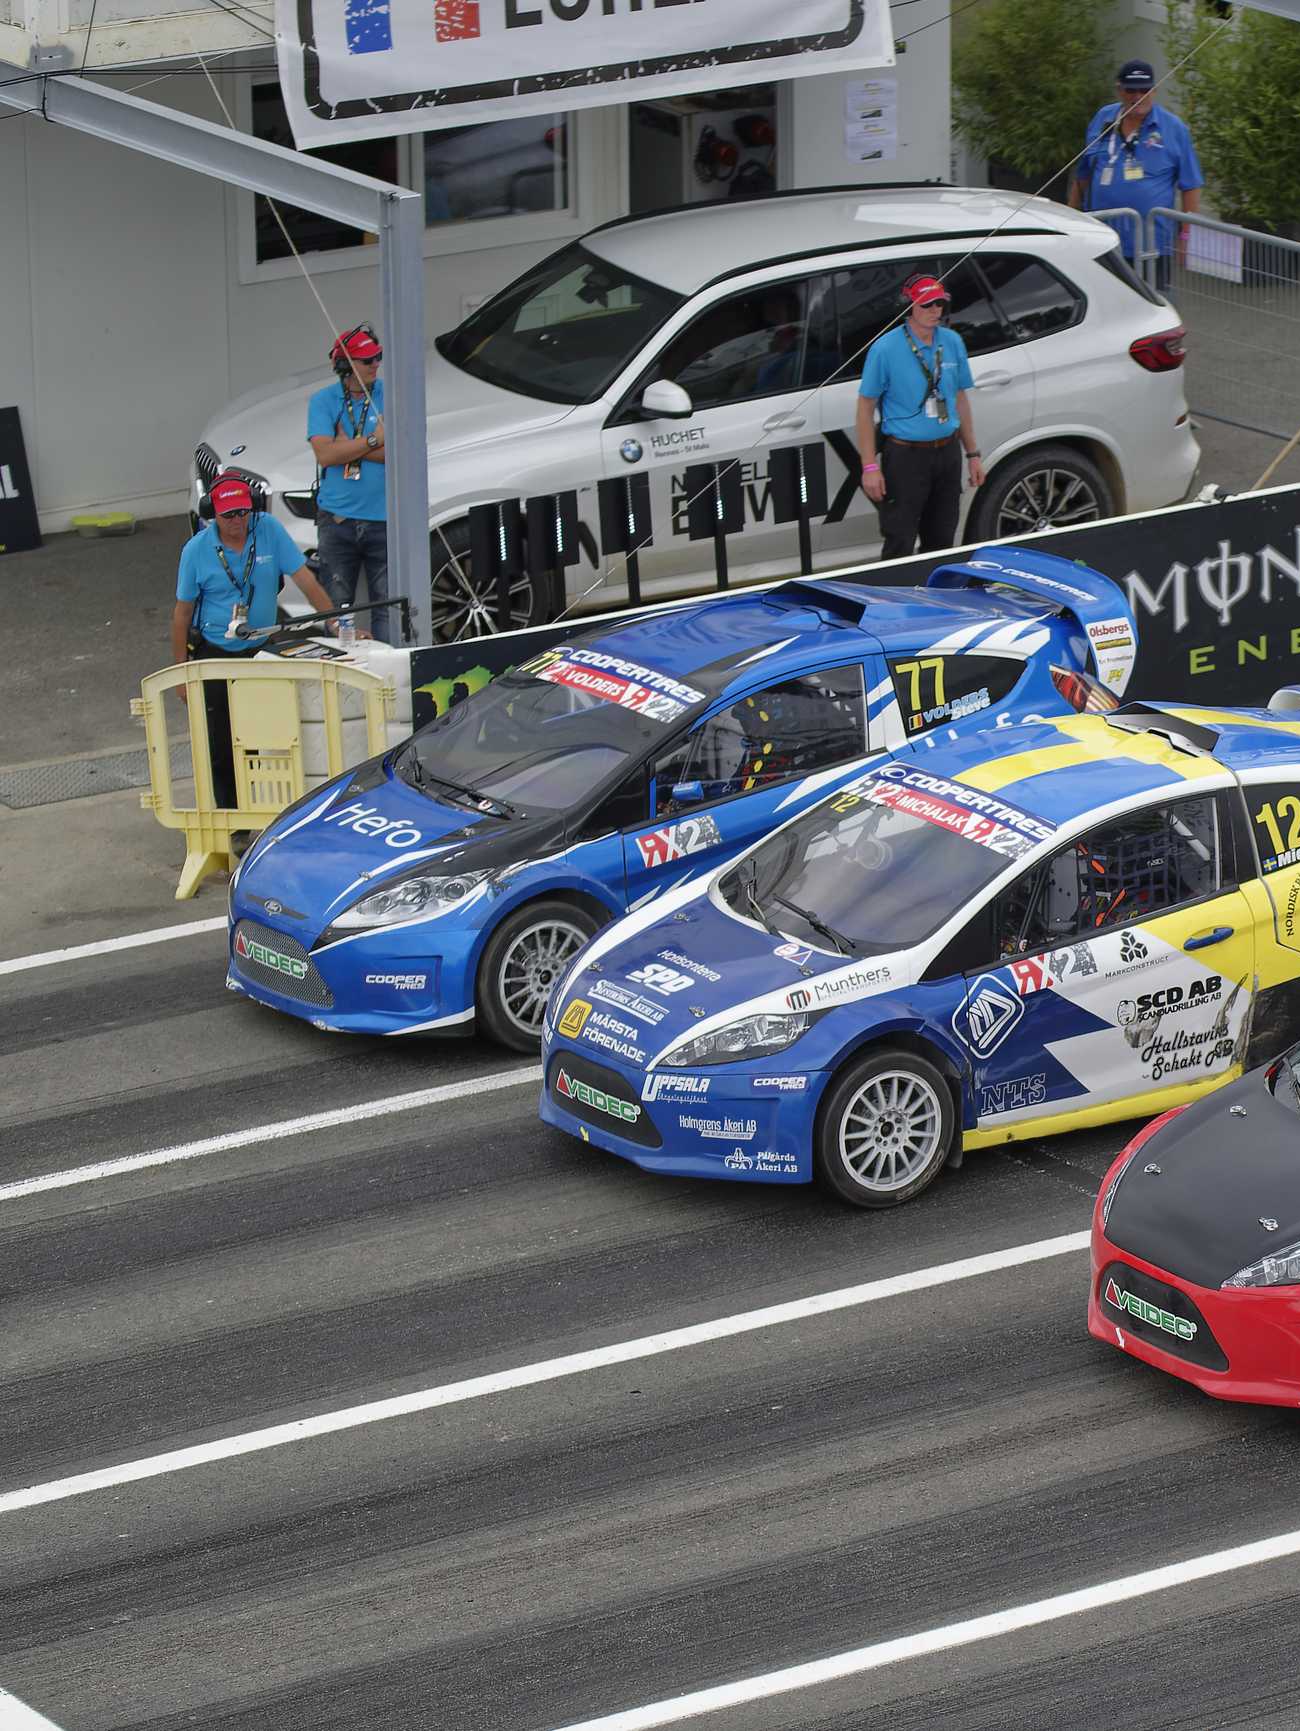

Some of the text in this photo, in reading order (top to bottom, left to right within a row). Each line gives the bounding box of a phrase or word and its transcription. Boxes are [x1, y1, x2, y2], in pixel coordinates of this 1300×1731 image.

[651, 427, 705, 448] HUCHET
[1089, 623, 1129, 638] Olsbergs
[566, 669, 626, 697] VOLDERS
[895, 657, 944, 711] 77
[831, 794, 861, 814] 12
[899, 794, 967, 829] MICHALAK
[324, 803, 422, 848] Hefo
[245, 937, 307, 980] VEIDEC
[1105, 955, 1169, 979] MARKCONSTRUCT
[365, 974, 427, 986] COOPER
[395, 982, 425, 990] TIRES
[628, 963, 695, 993] SPD
[814, 966, 890, 1001] Munthers
[1136, 975, 1222, 1013] SCD AB
[1137, 991, 1222, 1023] SCANDIADRILLING AB
[589, 1012, 638, 1040] MÄRSTA
[582, 1026, 646, 1063] FÖRENADE
[1152, 1049, 1202, 1080] Schakt
[641, 1073, 711, 1102] UPPSALA
[753, 1076, 807, 1087] COOPER
[981, 1073, 1046, 1116] NTS
[564, 1074, 639, 1124] VEIDEC
[679, 1115, 757, 1132] Holmgrens Åkeri AB
[755, 1161, 798, 1173] Åkeri AB
[1113, 1286, 1195, 1341] VEIDEC
